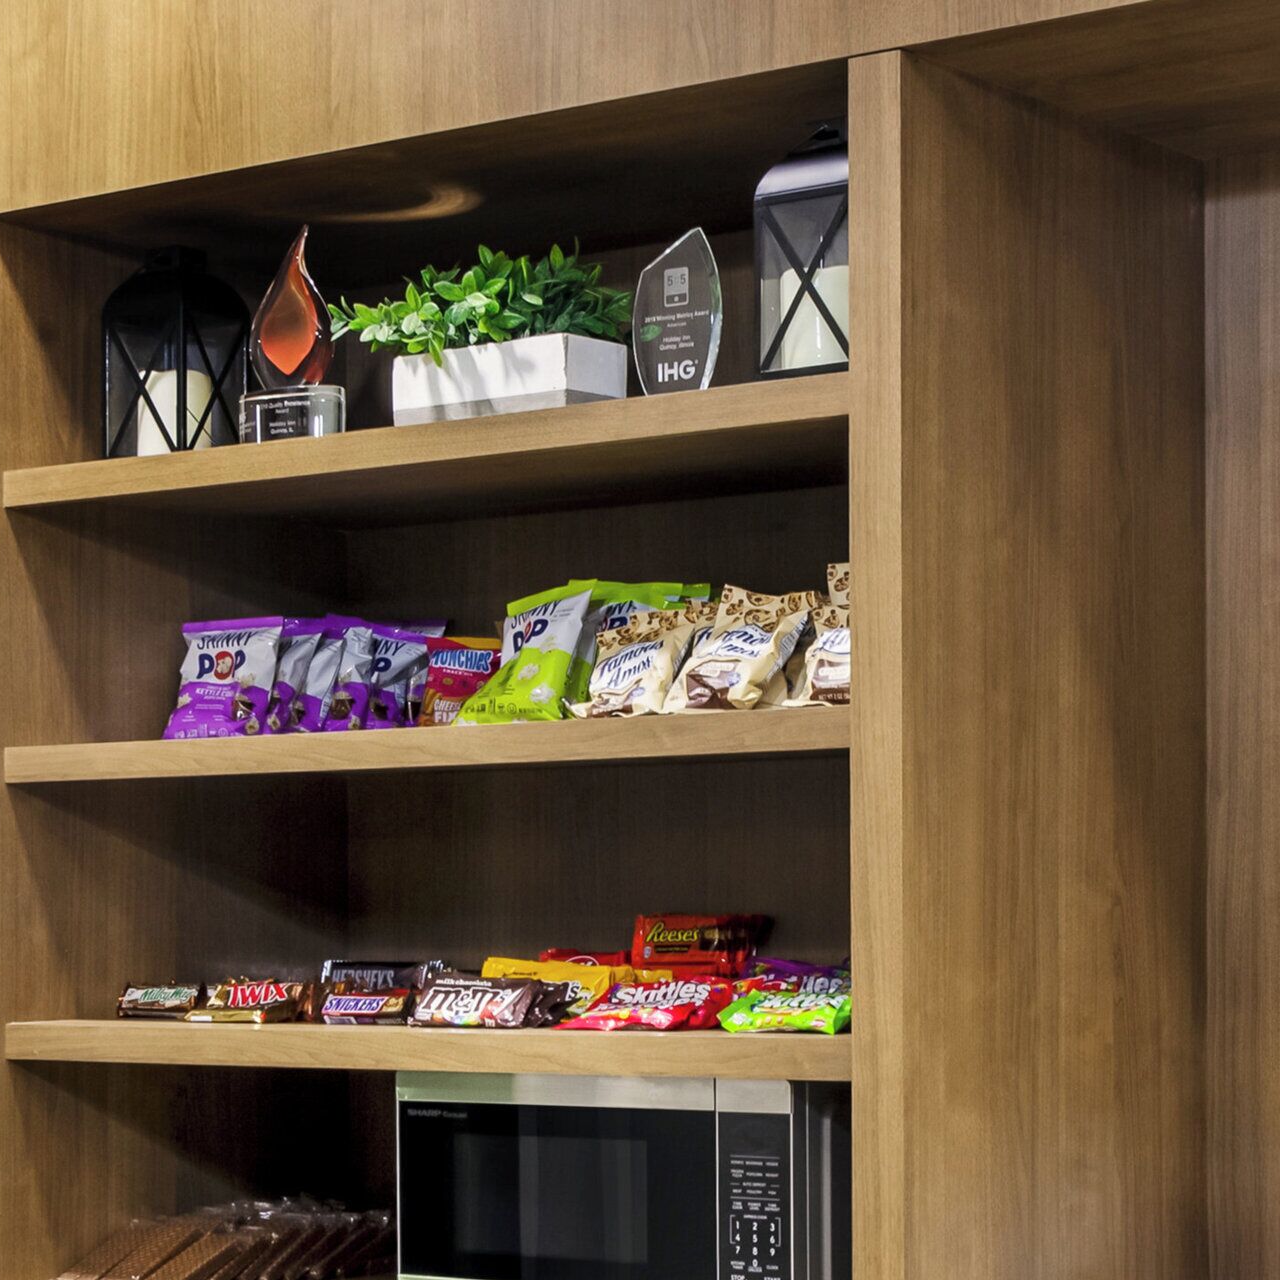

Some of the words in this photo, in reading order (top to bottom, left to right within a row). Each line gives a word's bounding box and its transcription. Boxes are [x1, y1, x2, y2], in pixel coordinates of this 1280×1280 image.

[657, 359, 696, 383] IHG
[197, 631, 259, 650] SKINNY
[196, 650, 246, 681] POP
[645, 922, 700, 944] Reese's
[226, 982, 290, 1008] TWIX
[612, 981, 712, 1007] Skittles
[322, 995, 386, 1013] SNICKERS
[752, 1221, 758, 1231] 2
[769, 1222, 776, 1232] 3
[735, 1233, 741, 1242] 4
[752, 1234, 758, 1243] 5
[769, 1235, 776, 1244] 6
[735, 1245, 741, 1254] 7
[752, 1246, 759, 1256] 8
[769, 1247, 776, 1257] 9
[752, 1258, 758, 1268] 0
